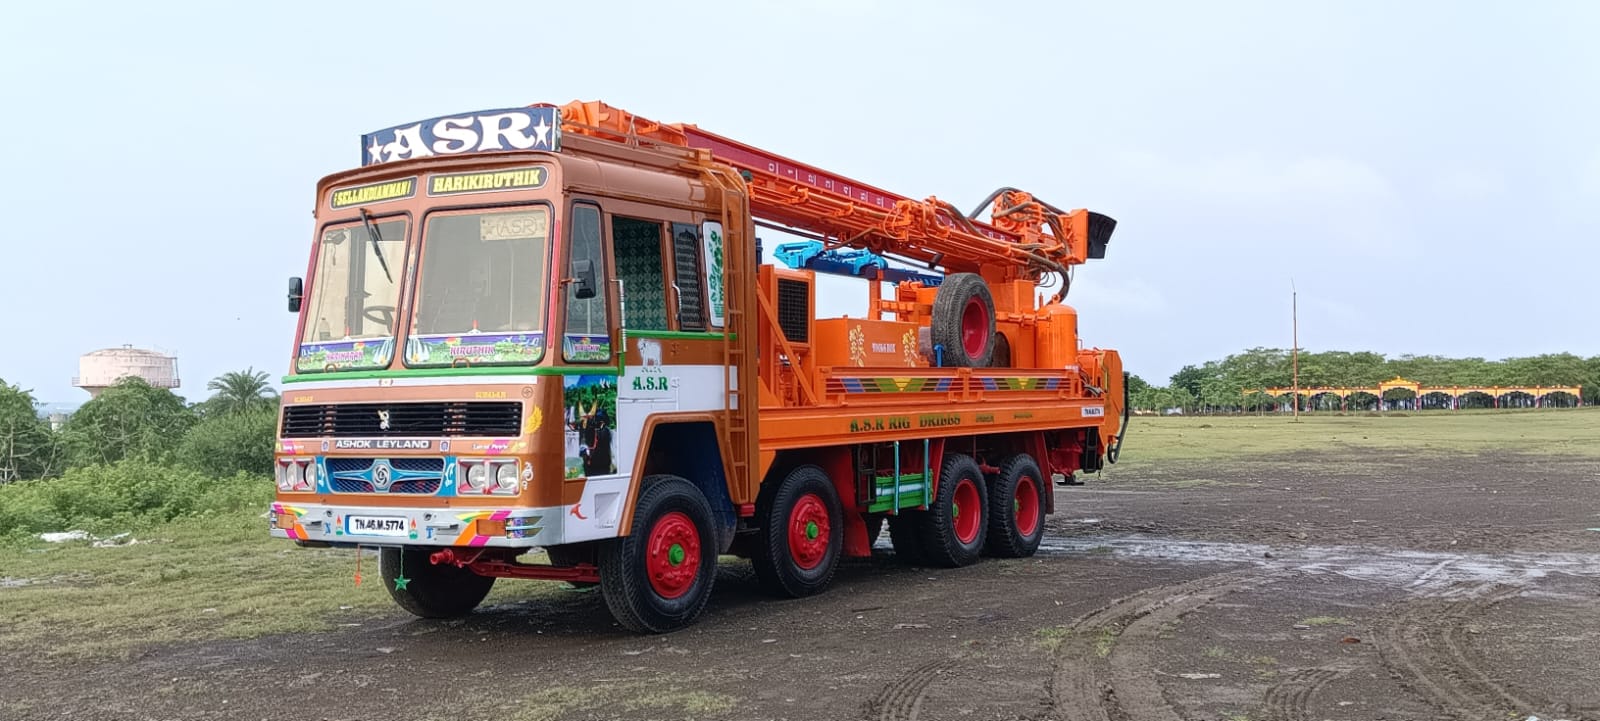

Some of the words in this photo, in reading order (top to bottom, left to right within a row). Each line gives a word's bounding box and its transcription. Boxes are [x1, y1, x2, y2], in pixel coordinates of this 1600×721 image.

[382, 112, 536, 164] ASR
[432, 170, 541, 193] HARIKIRUTHIK
[632, 376, 668, 391] A.S.R
[850, 416, 885, 432] A.S.R
[888, 415, 911, 430] RIG
[335, 440, 371, 449] ASHOK
[376, 439, 429, 448] LEYLAND
